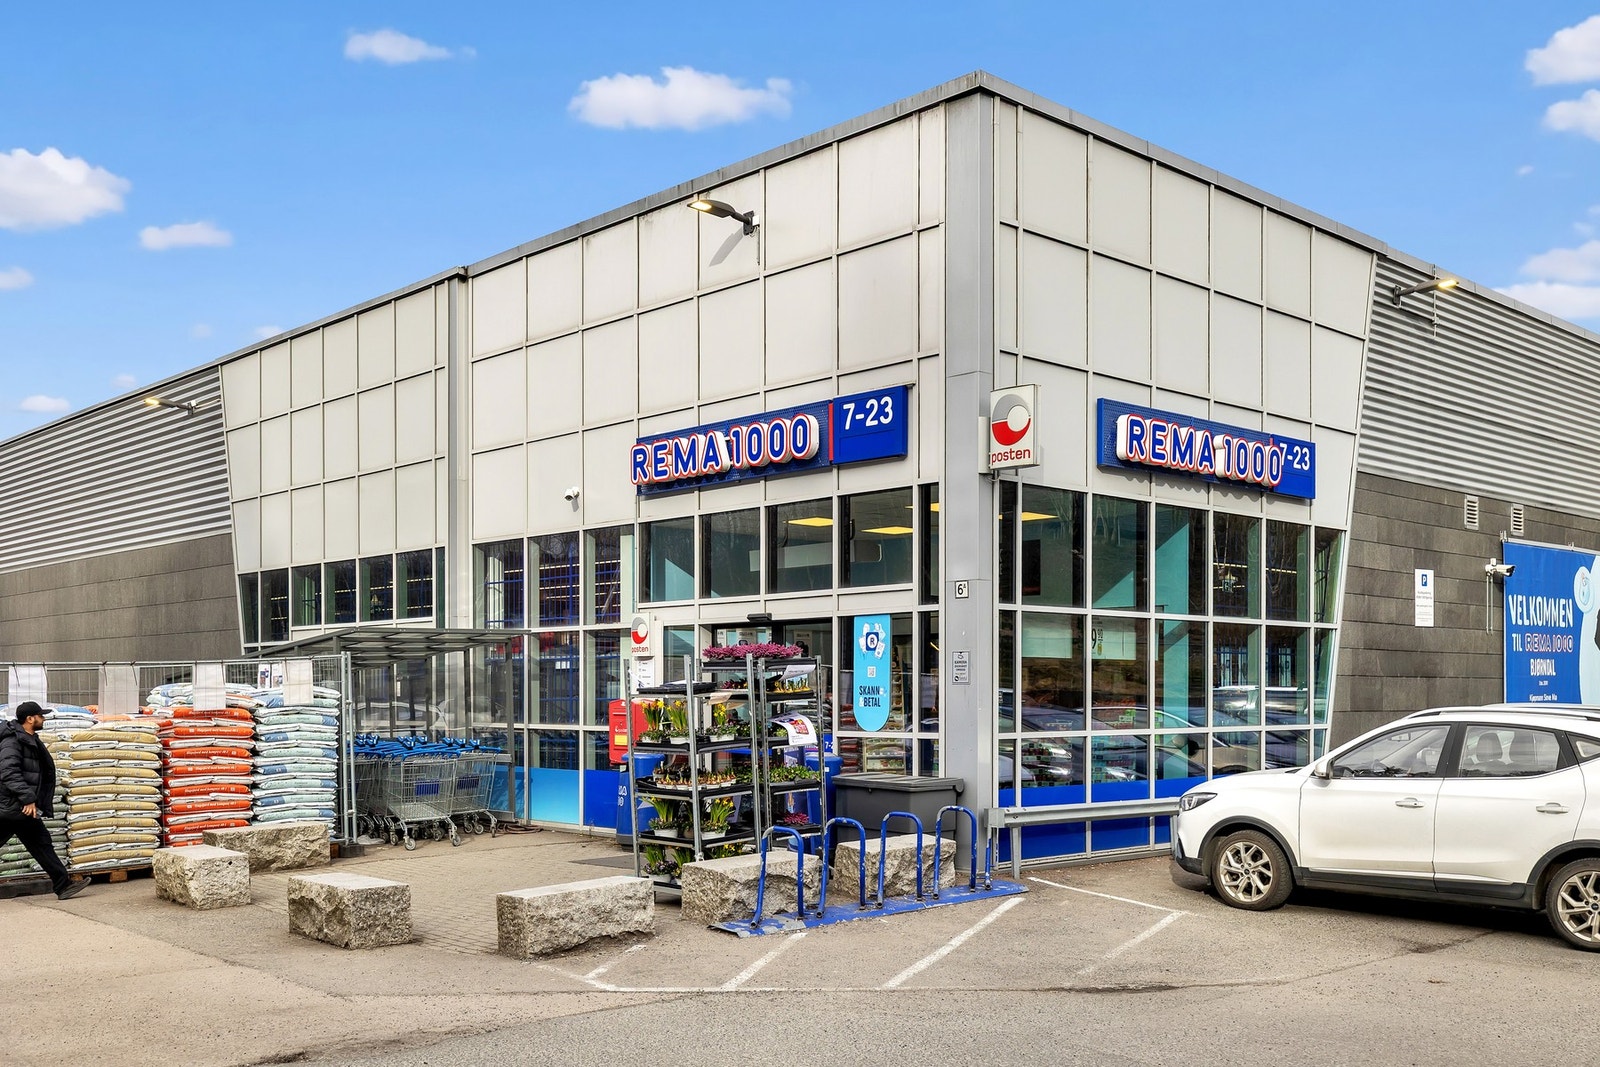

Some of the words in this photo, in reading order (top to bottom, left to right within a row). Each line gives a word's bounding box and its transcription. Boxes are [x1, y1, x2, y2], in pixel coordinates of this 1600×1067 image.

[842, 396, 894, 430] 7-23
[630, 430, 723, 486] REMA
[729, 413, 811, 470] 1000
[990, 447, 1031, 465] posten
[1126, 413, 1217, 475] REMA
[1221, 432, 1283, 487] 1000
[1280, 442, 1311, 471] 7-23
[1508, 594, 1574, 628] VELKOMMEN
[1512, 633, 1523, 652] TIL
[859, 685, 880, 696] SKANN
[863, 697, 881, 707] BETAL
